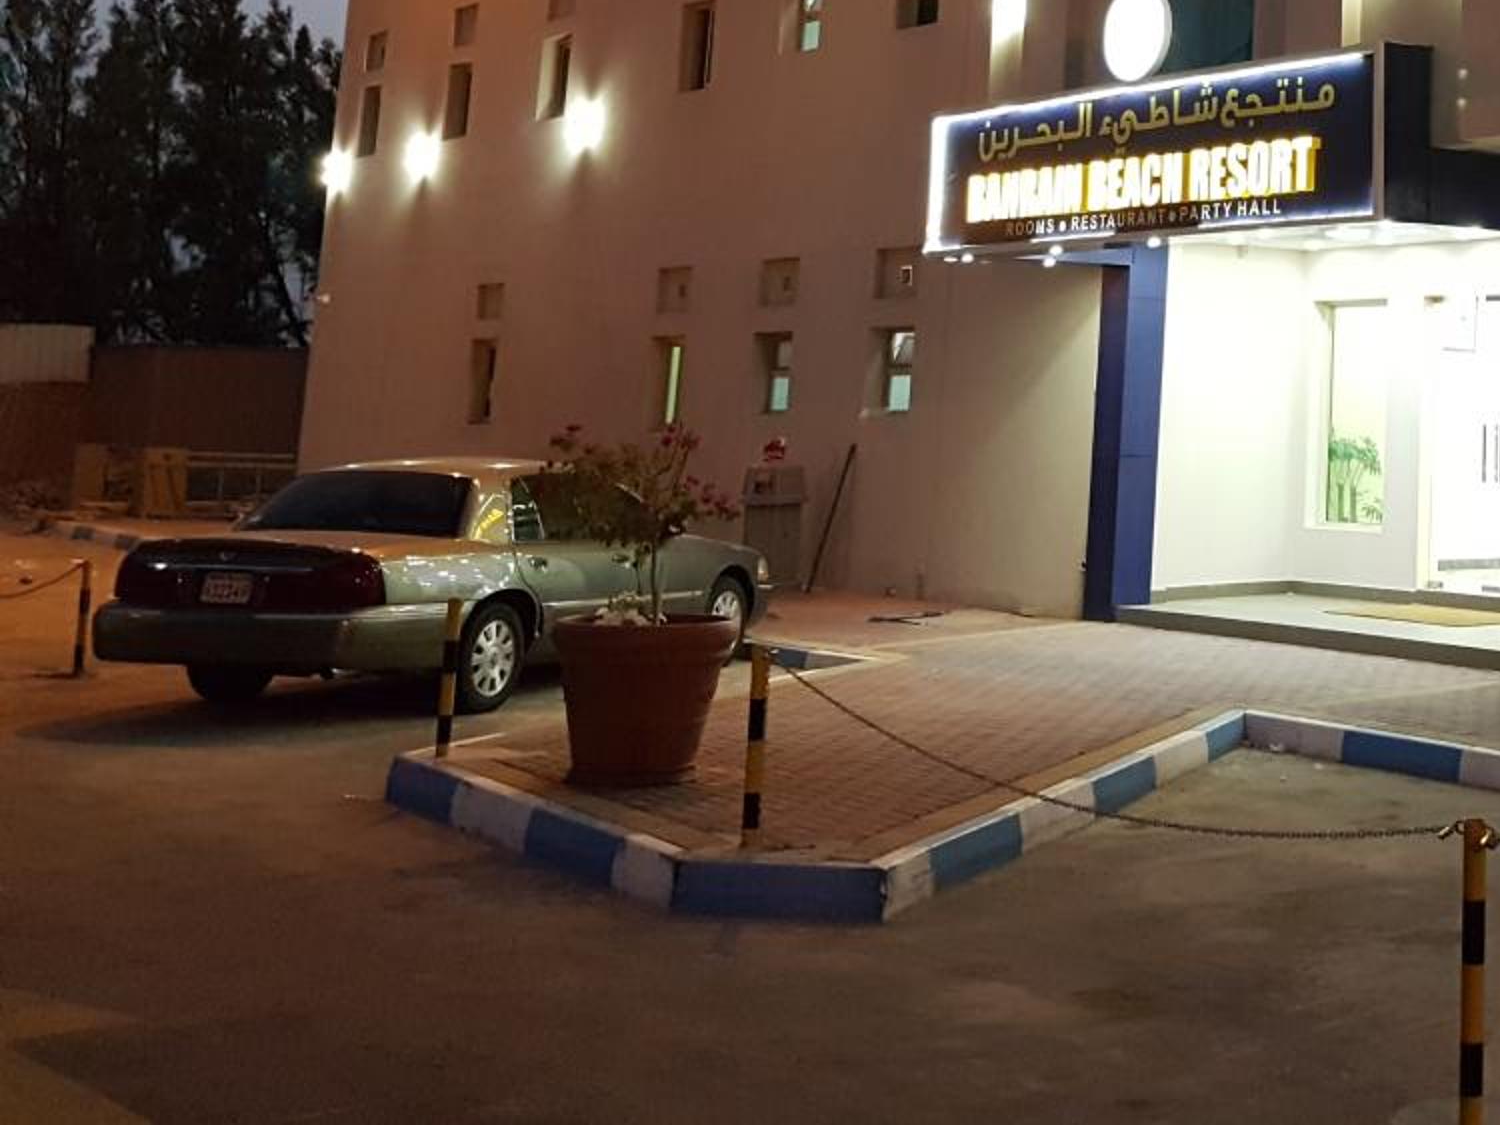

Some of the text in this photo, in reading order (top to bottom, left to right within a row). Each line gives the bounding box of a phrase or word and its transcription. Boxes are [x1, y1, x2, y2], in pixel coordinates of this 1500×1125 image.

[1219, 76, 1336, 128] منتجع
[978, 101, 1094, 163] البحرين
[966, 135, 1321, 224] BAHRAIN BEACH RESORT
[1006, 198, 1282, 236] ROOMS RESTAURANT PARTY HALL
